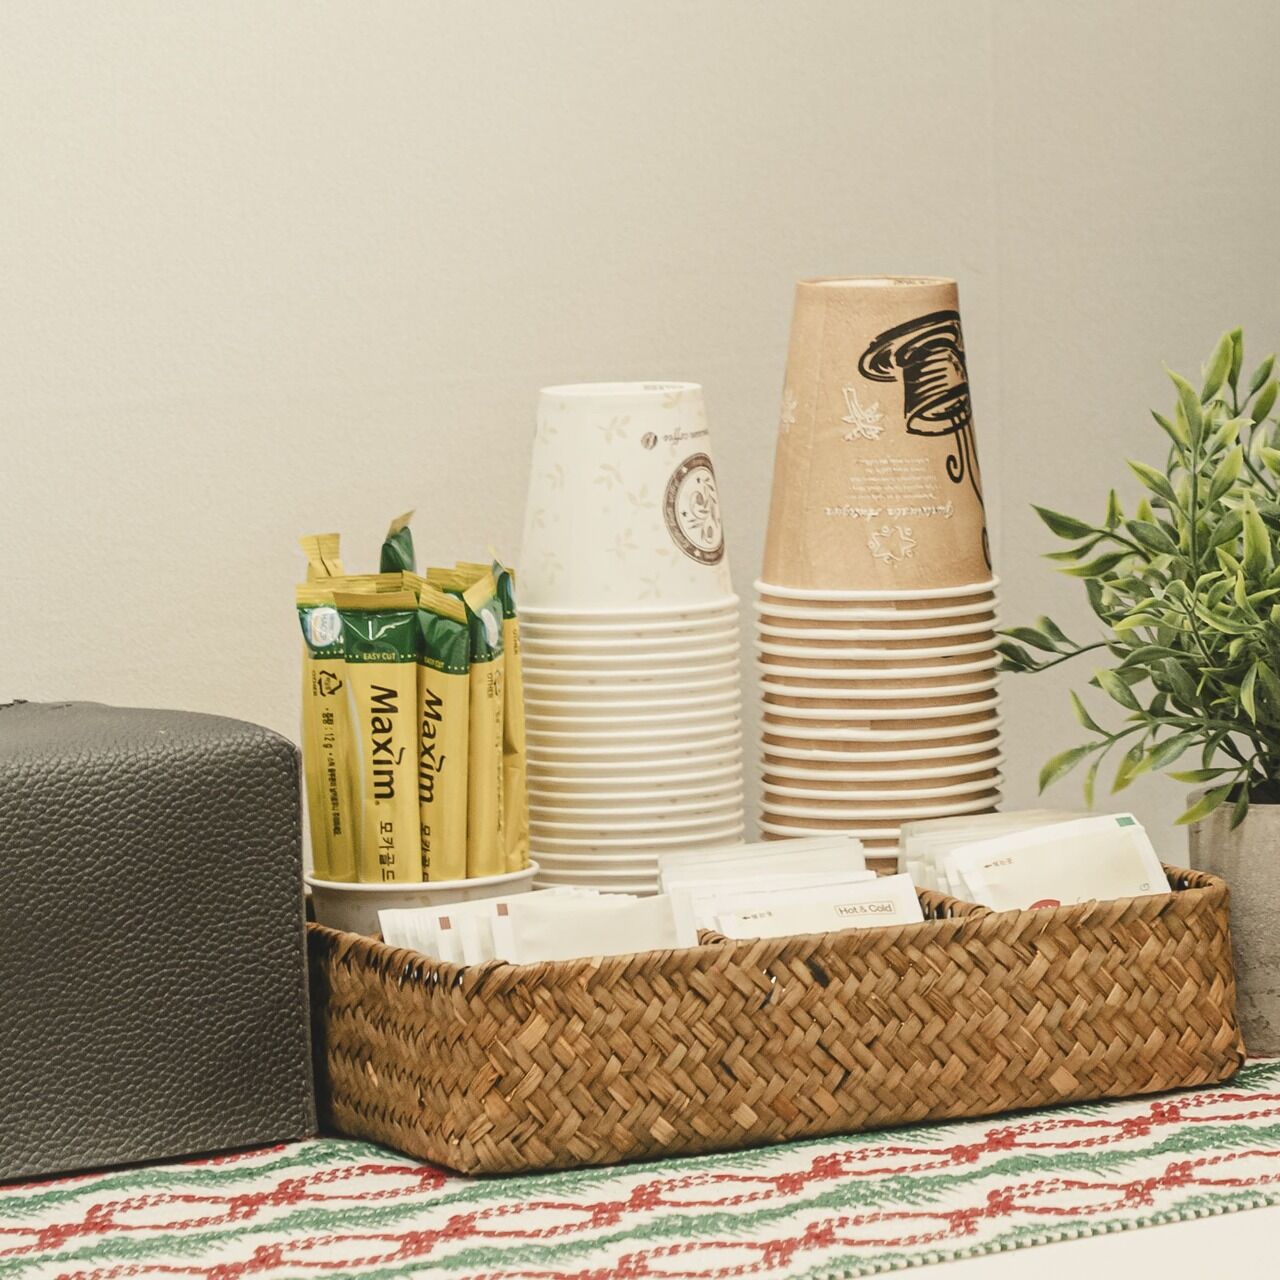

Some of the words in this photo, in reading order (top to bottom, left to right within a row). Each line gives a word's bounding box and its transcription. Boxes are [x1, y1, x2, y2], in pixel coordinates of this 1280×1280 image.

[371, 684, 406, 800] Maxim
[419, 688, 446, 804] Maxim
[379, 821, 395, 882] 모카골드
[838, 905, 857, 915] Hot
[868, 904, 893, 913] Cold
